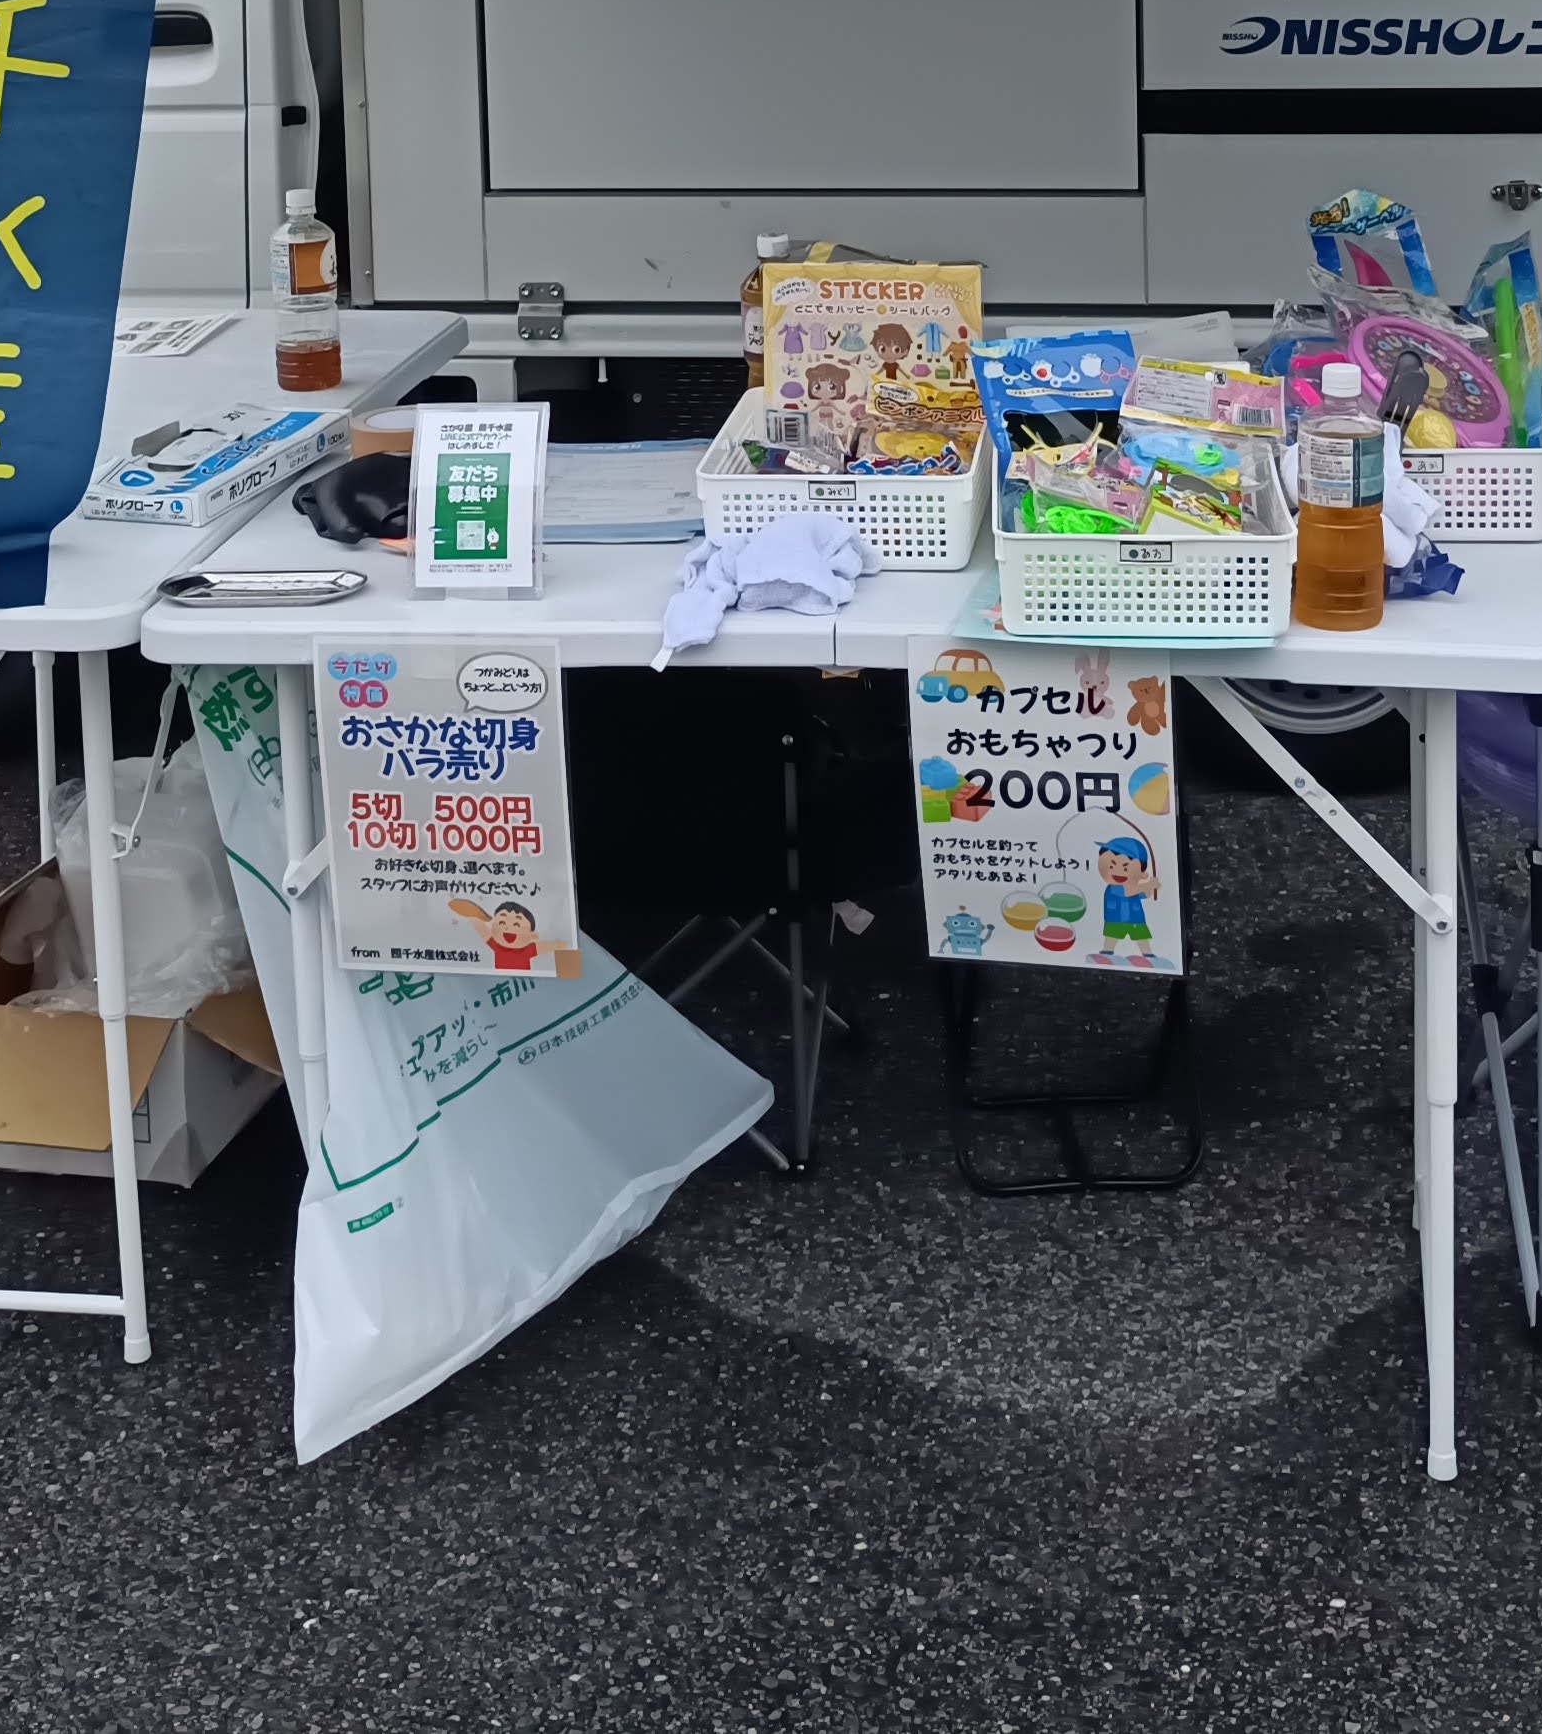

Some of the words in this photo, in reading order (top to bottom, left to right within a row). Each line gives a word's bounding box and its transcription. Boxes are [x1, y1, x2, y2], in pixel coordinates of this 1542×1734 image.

[819, 280, 925, 301] STICKER
[448, 464, 499, 483] 友だち
[332, 657, 392, 675] 今だけ
[473, 667, 530, 679] つかみどりは
[976, 685, 1106, 715] カプセル
[341, 715, 540, 751] おさかな切身
[946, 728, 1138, 760] おもちゃつり
[382, 747, 506, 781] バラ売り
[965, 768, 1121, 814] 200円
[351, 792, 402, 822] 5切
[434, 795, 532, 825] 500円
[347, 821, 416, 850] 10切
[425, 823, 541, 854] 1000円
[934, 868, 1037, 884] アタリもあるよ!
[350, 946, 380, 959] from
